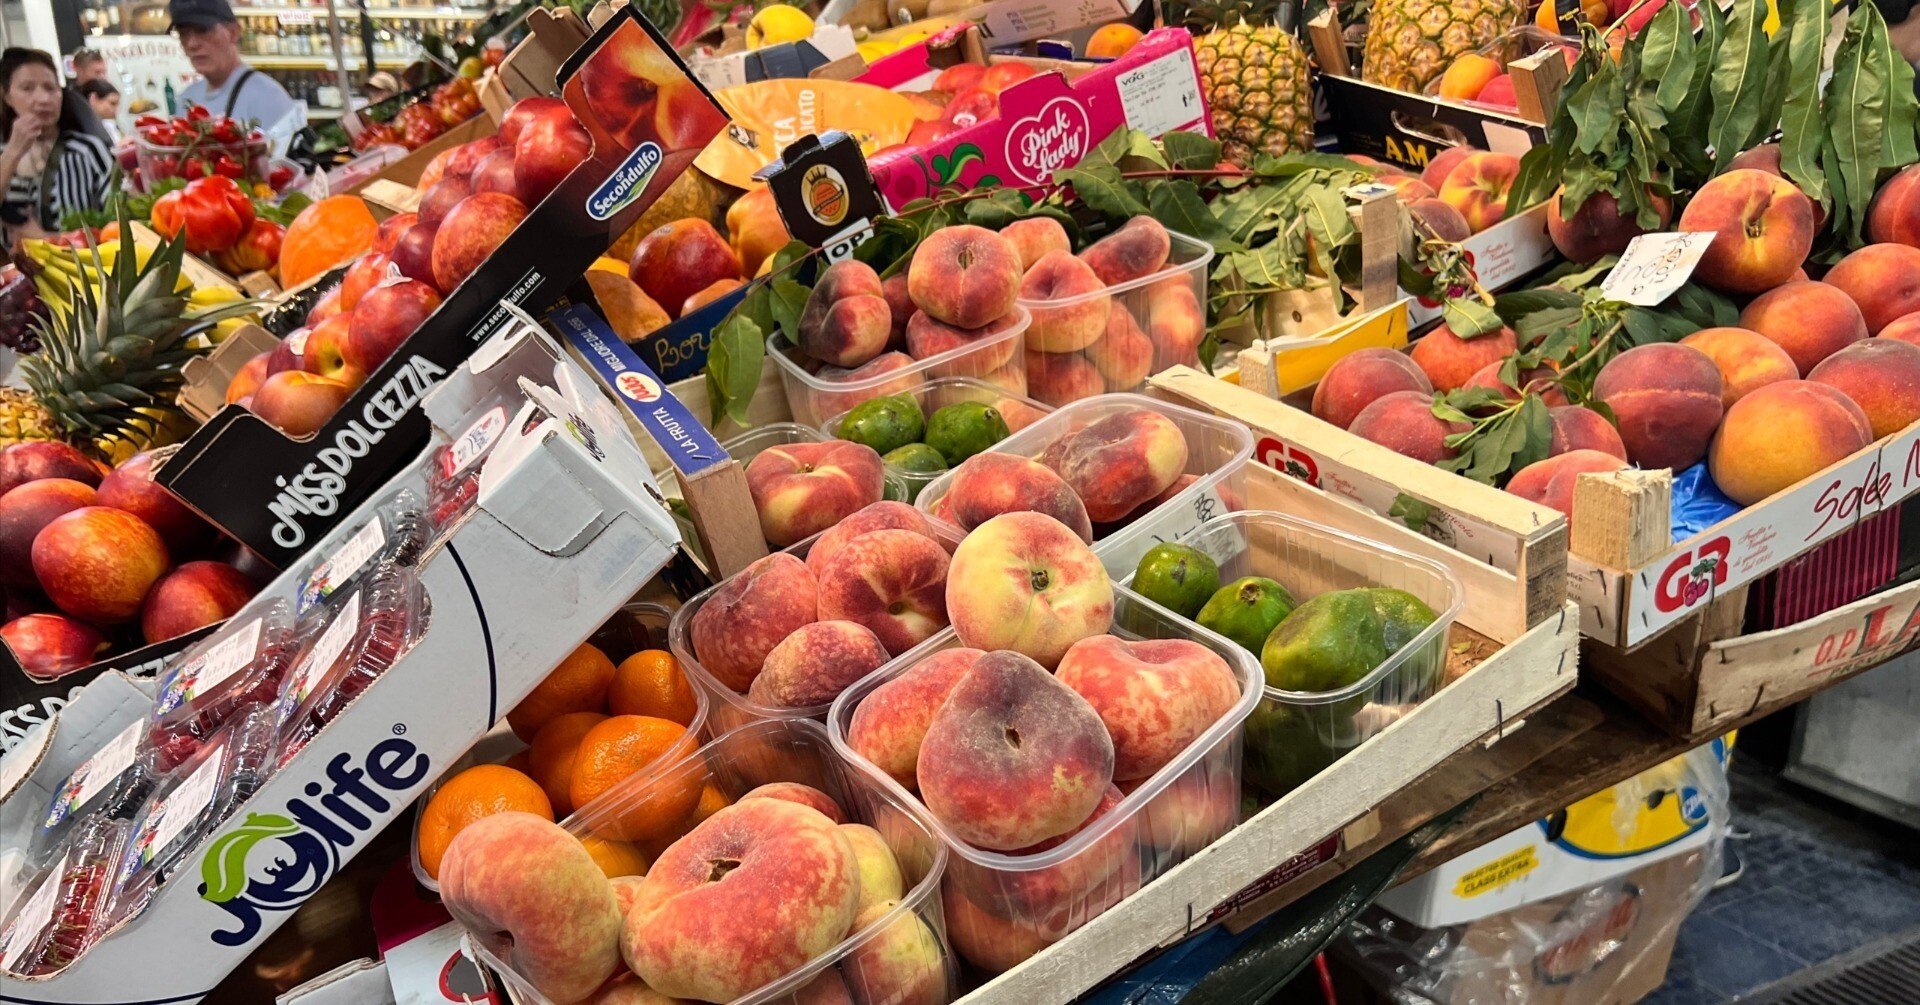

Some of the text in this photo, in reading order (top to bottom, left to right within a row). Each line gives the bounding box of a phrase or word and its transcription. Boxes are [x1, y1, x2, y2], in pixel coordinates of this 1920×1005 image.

[1021, 107, 1070, 166] Pink
[1033, 131, 1080, 182] Lady
[594, 149, 658, 215] Secondulfo
[472, 272, 541, 342] www.secoulfo.com
[591, 341, 627, 372] MIGLIORE
[653, 407, 699, 453] LA FRUTTA
[1815, 628, 1857, 667] O.P.
